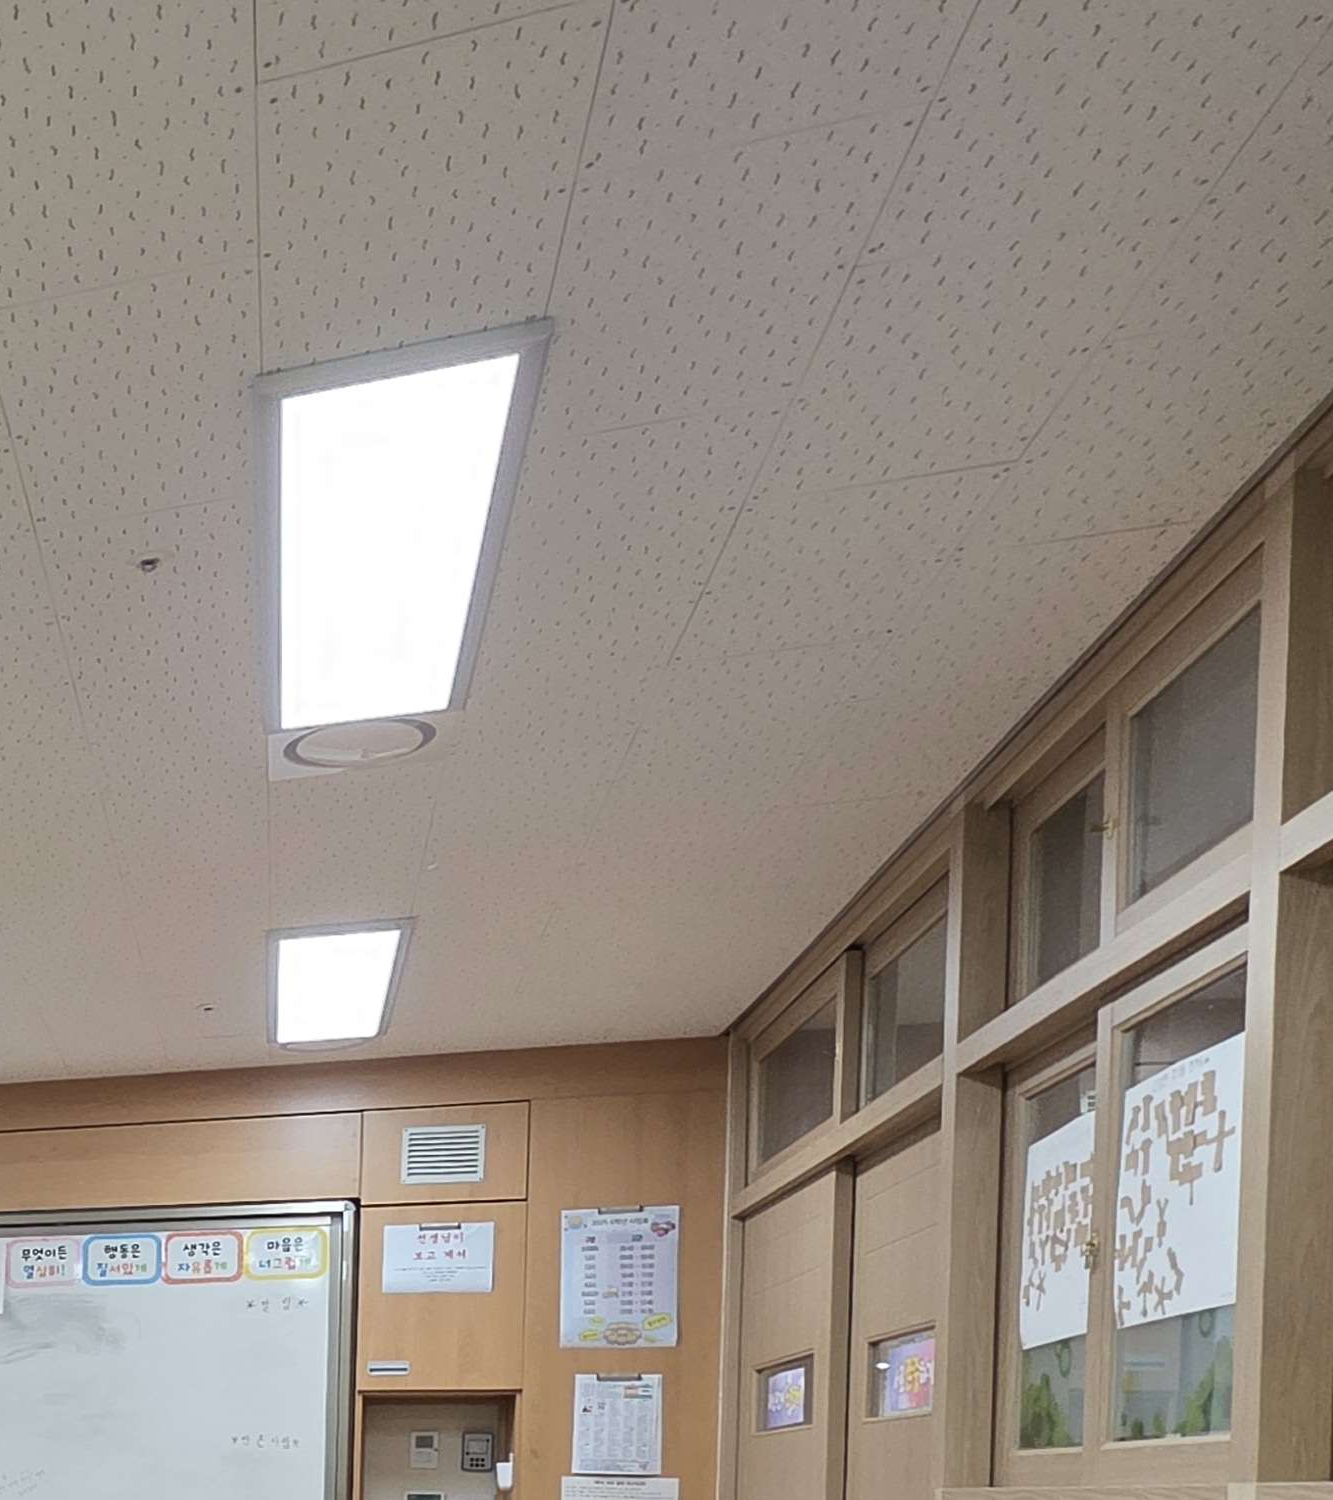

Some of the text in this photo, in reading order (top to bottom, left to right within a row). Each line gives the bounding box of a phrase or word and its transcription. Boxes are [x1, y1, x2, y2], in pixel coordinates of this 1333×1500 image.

[104, 1243, 141, 1259] 행동은
[182, 1241, 222, 1257] 생각은
[267, 1237, 303, 1252] 마음은
[21, 1245, 67, 1262] 무엇이든
[96, 1262, 148, 1277] 질서있게
[178, 1259, 228, 1274] 자유롭게
[259, 1256, 312, 1270] 너그럽게
[23, 1264, 65, 1279] 열심히!
